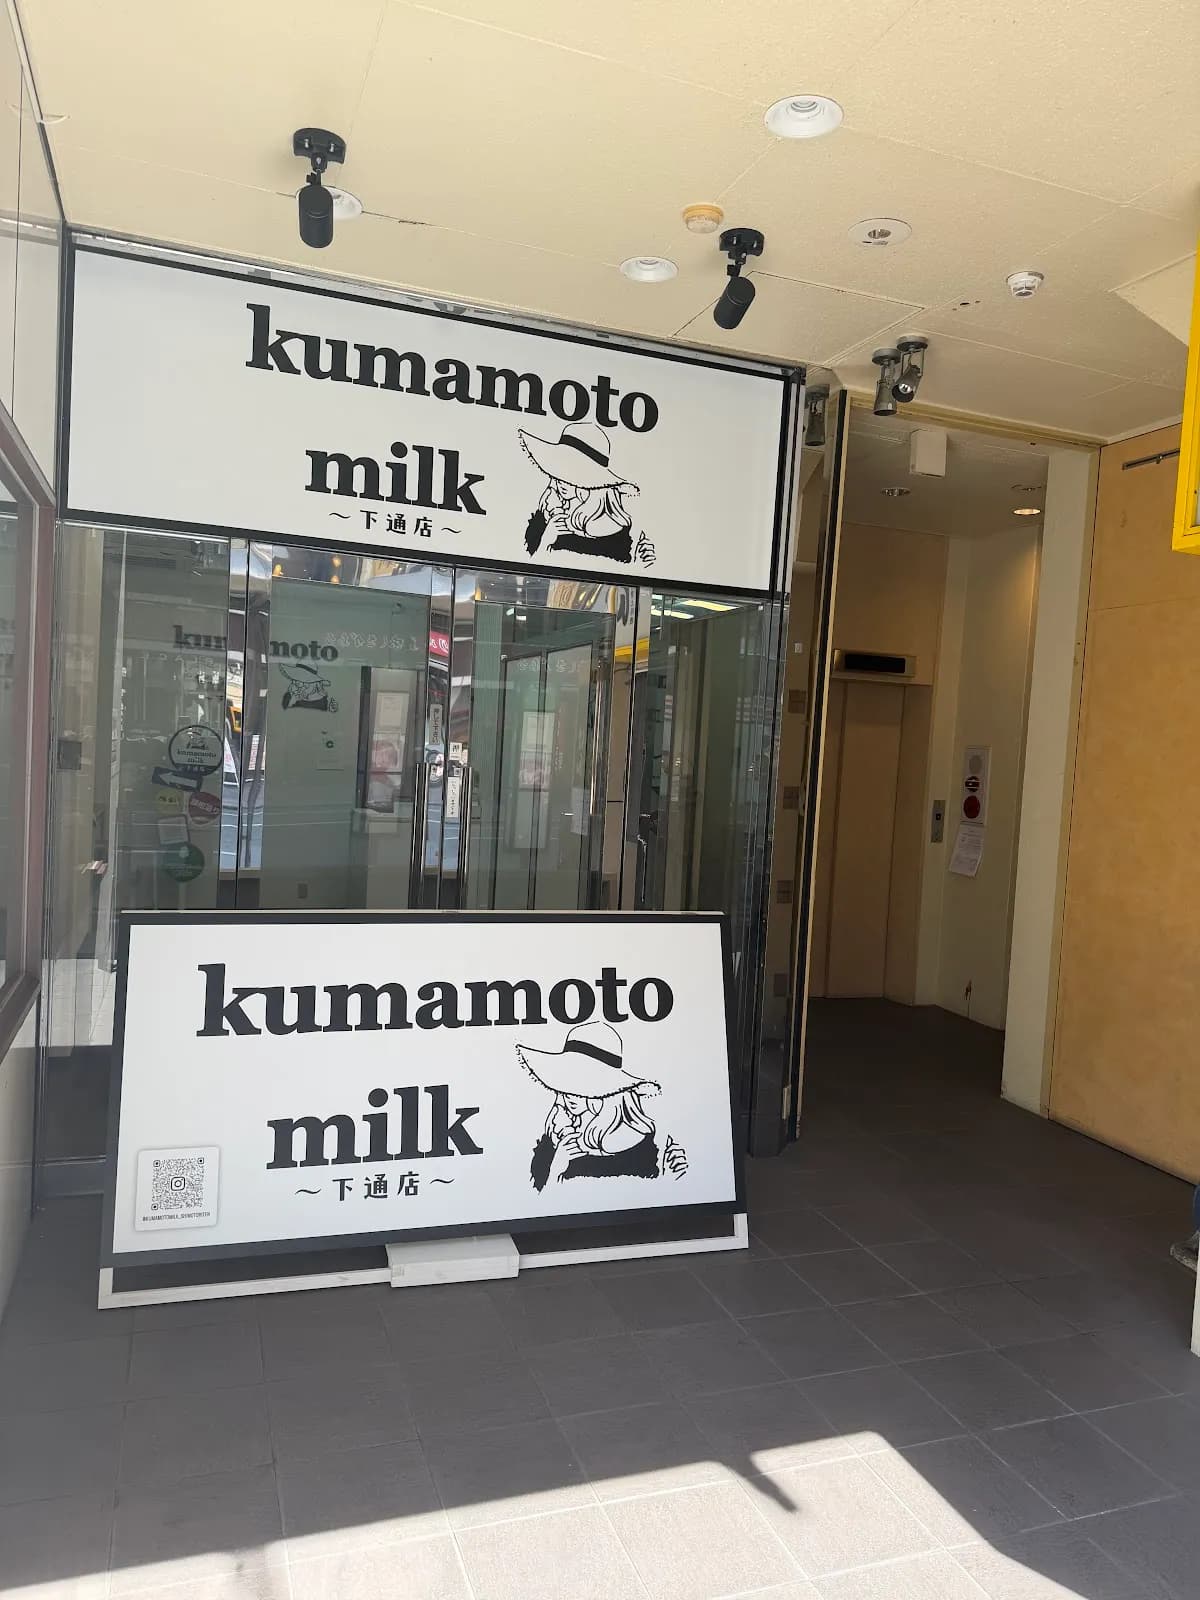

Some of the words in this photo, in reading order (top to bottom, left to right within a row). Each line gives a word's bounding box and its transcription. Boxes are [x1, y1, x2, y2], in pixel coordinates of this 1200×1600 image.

[246, 303, 658, 432] kumamoto
[305, 442, 486, 515] milk
[196, 963, 674, 1037] kumamoto
[266, 1085, 483, 1169] milk
